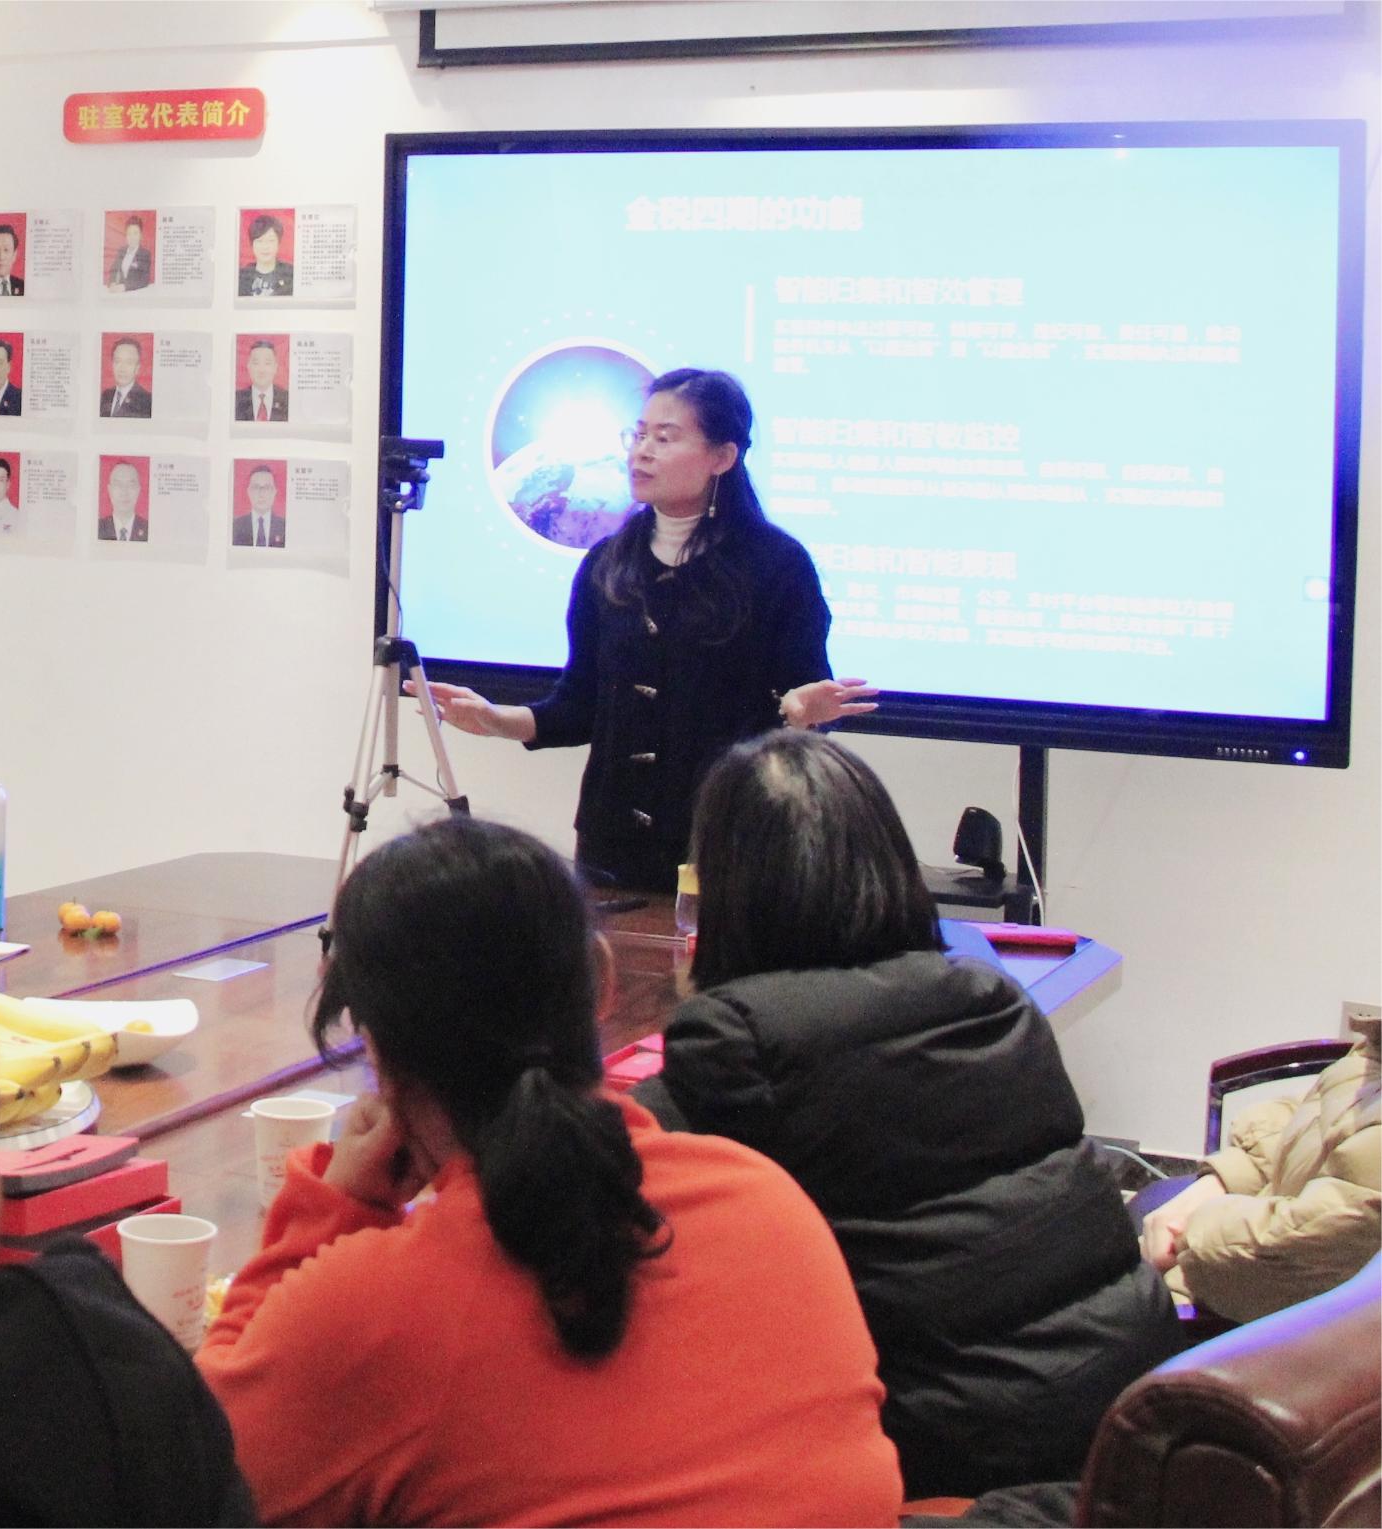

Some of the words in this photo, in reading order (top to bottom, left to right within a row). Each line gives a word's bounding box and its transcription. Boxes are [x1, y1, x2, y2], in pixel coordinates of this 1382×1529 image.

[77, 99, 250, 131] 驻室党代表简介
